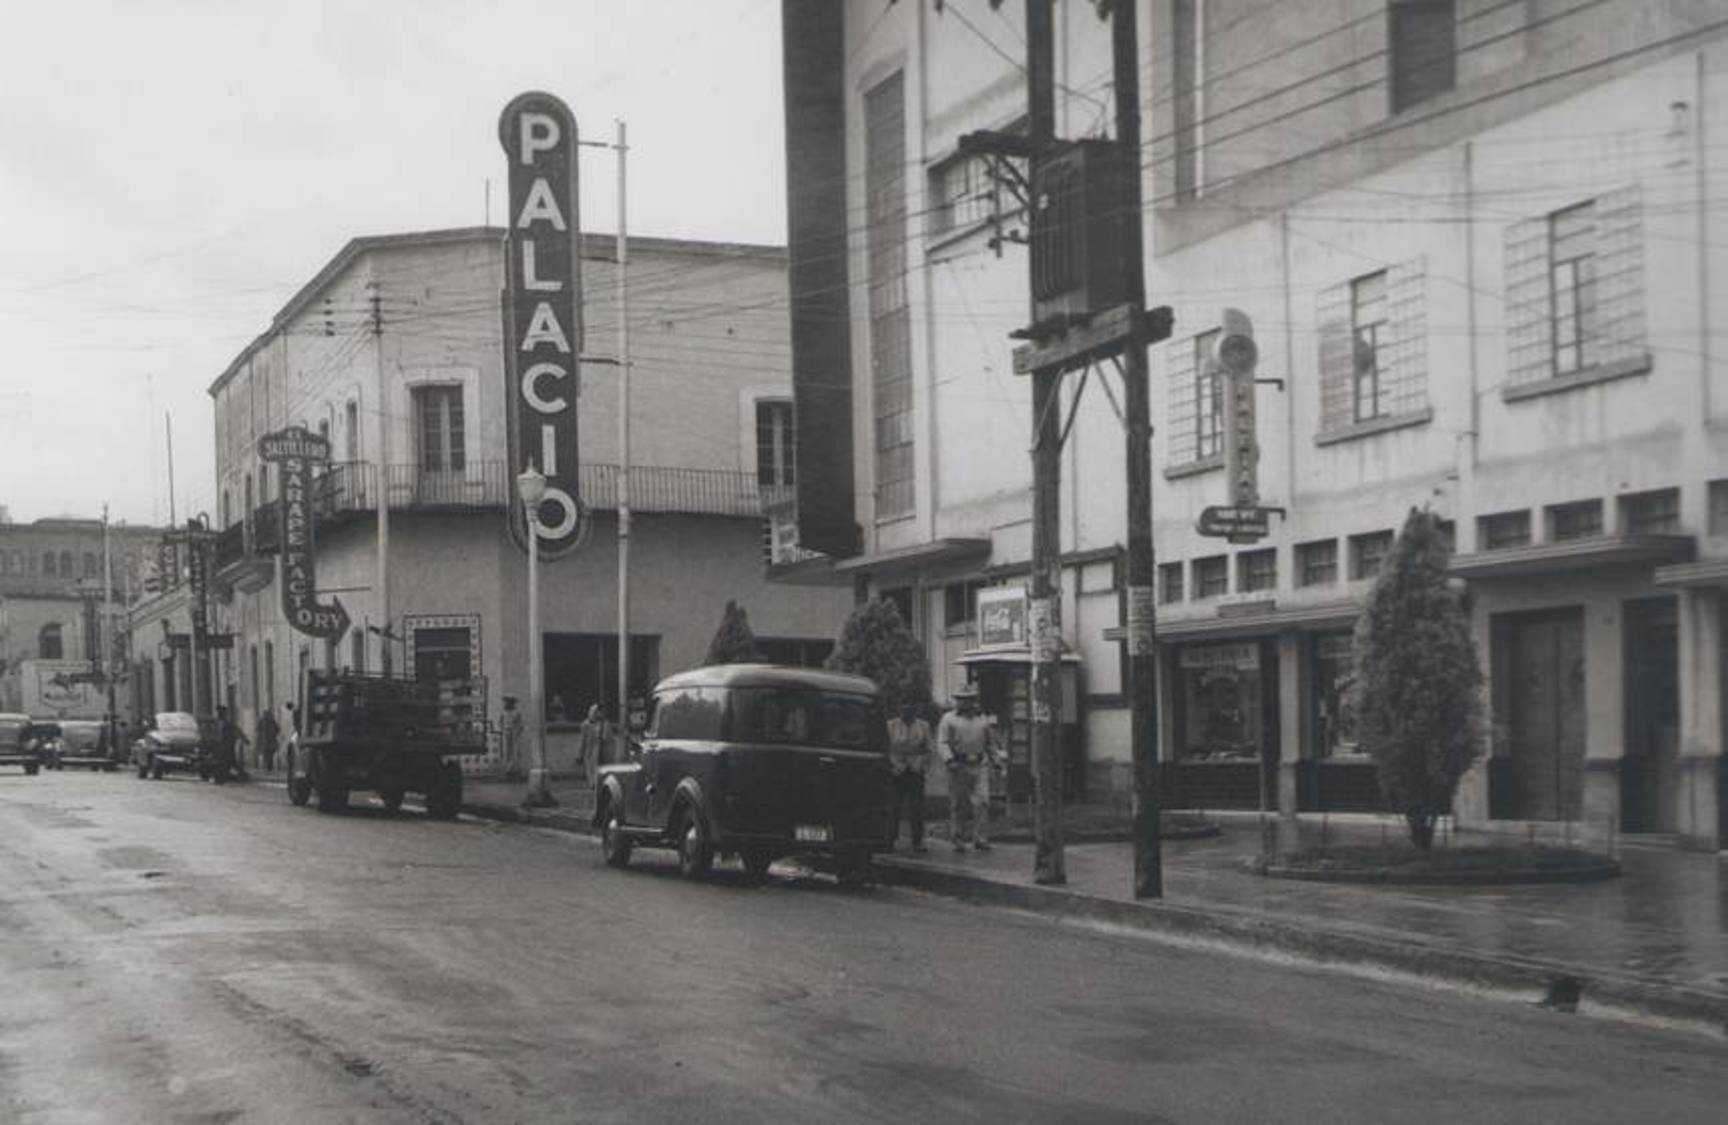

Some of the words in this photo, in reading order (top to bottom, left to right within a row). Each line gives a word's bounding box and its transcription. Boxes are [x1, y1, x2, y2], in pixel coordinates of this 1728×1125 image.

[517, 112, 578, 539] PALACIO
[286, 460, 305, 545] SARAPE
[287, 552, 343, 628] FACTORY
